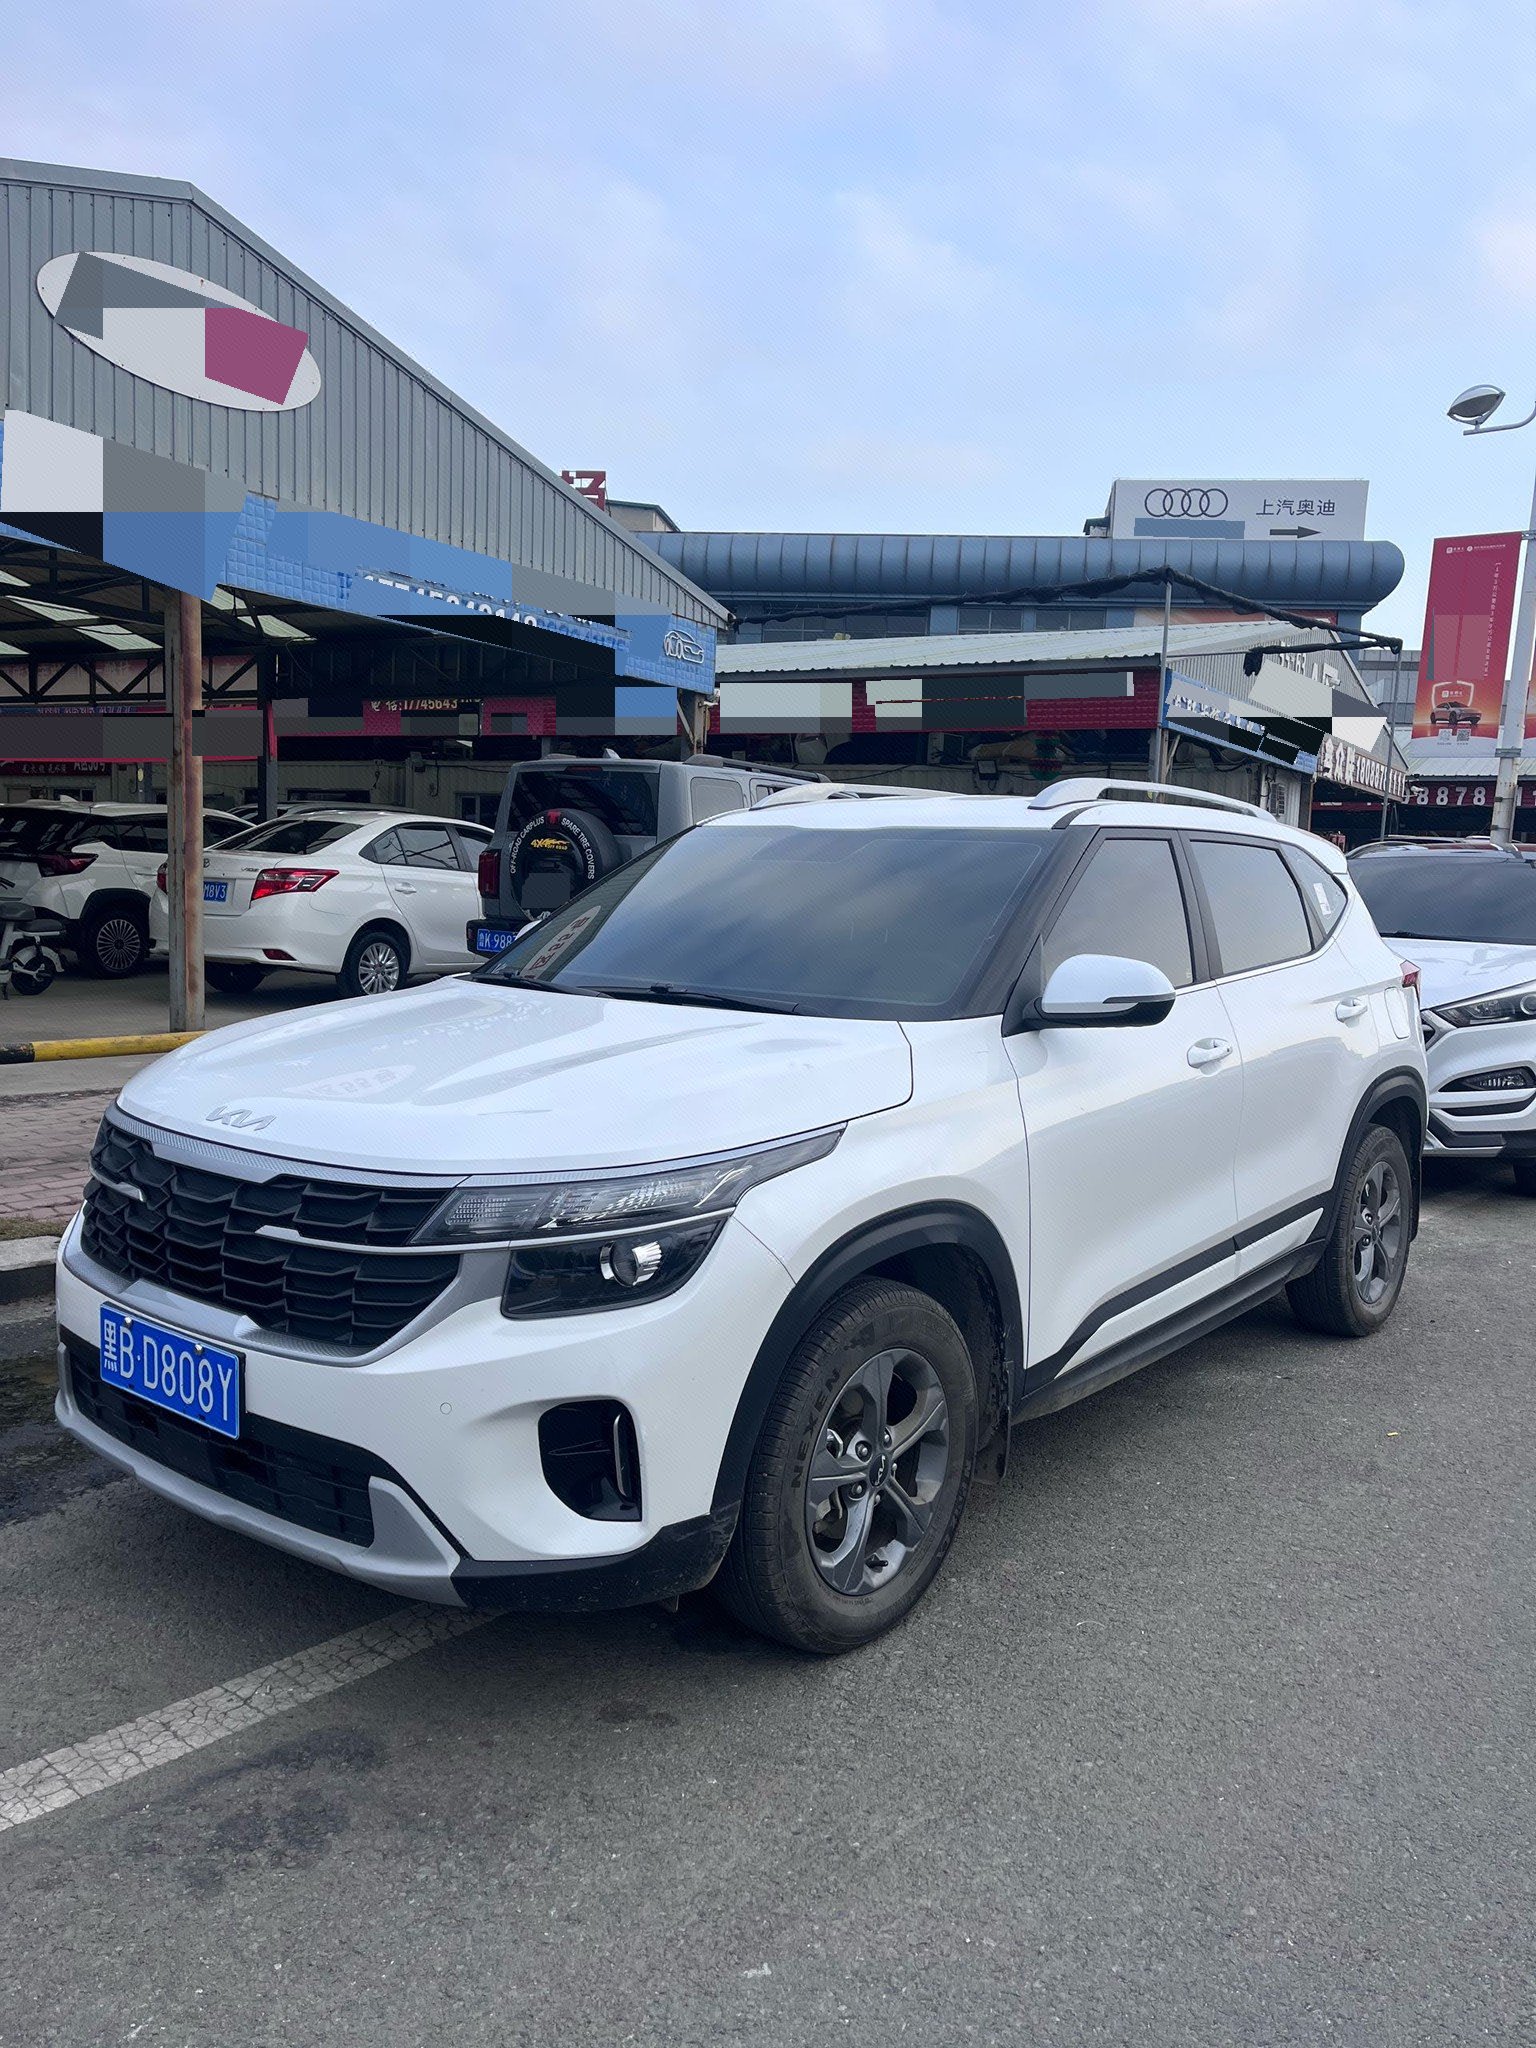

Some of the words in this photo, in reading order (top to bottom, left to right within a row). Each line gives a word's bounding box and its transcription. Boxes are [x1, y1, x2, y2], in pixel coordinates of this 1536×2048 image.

[1256, 499, 1336, 516] 上汽奥迪
[520, 816, 545, 839] CARPLUS
[561, 817, 581, 836] SPARE
[578, 832, 590, 850] TIRE
[585, 848, 595, 880] COVERS
[205, 1105, 277, 1131] KIA
[104, 1319, 233, 1421] 黑B·D808Y
[790, 1367, 841, 1488] NEXEN
